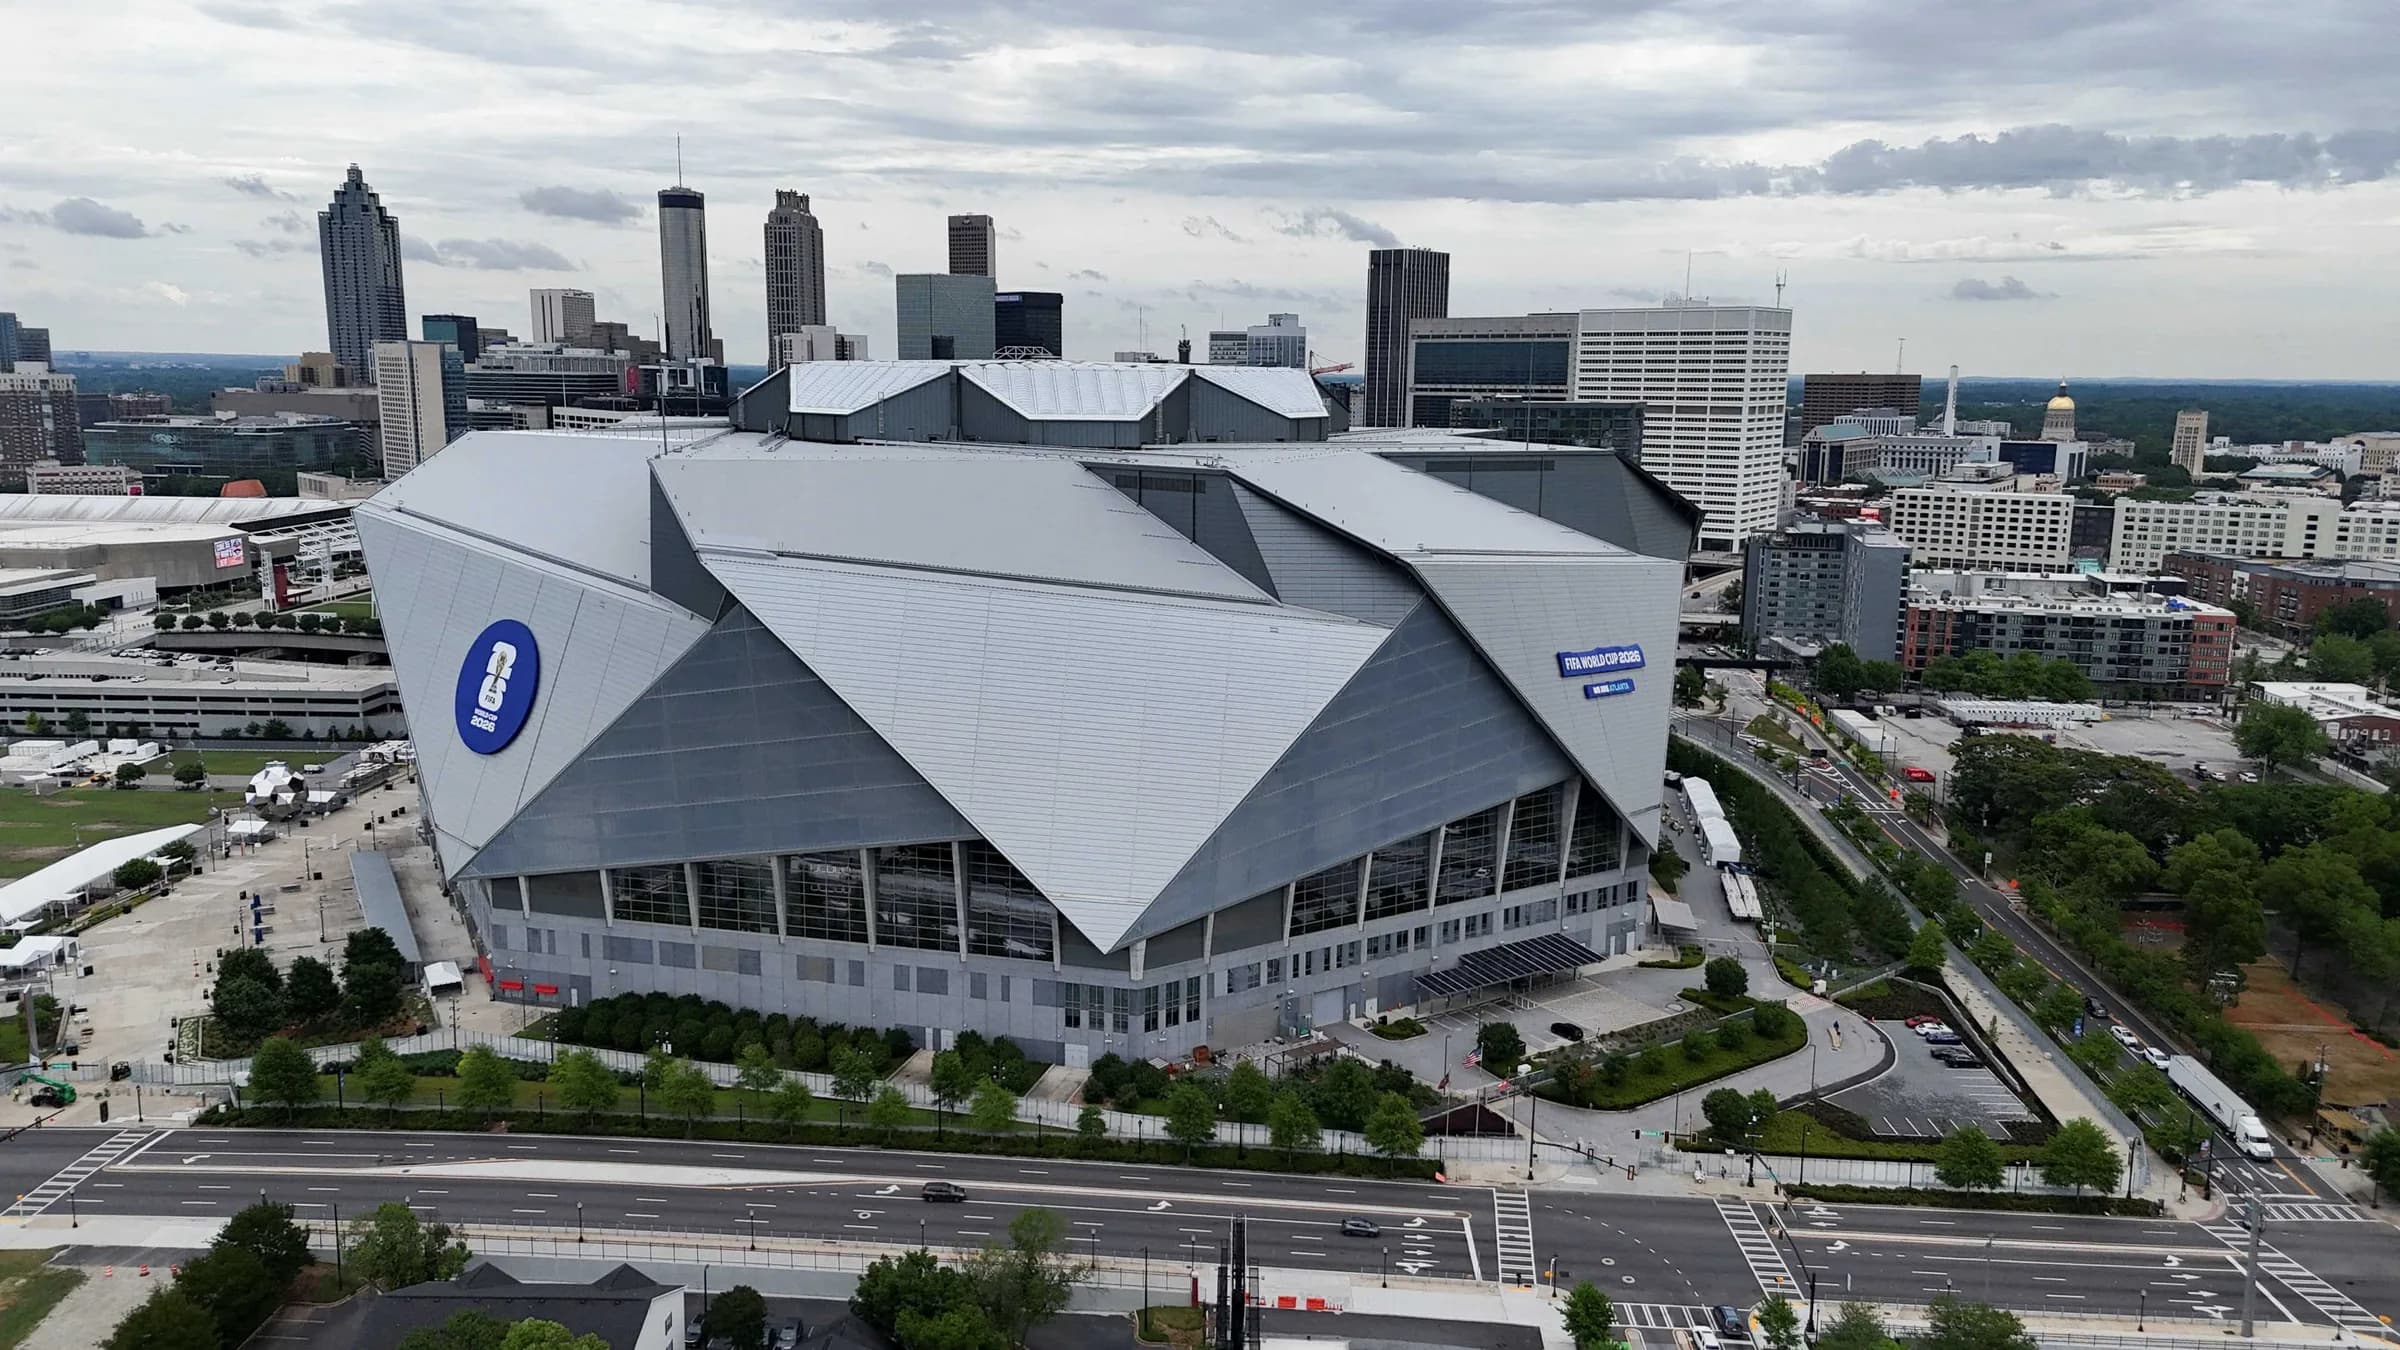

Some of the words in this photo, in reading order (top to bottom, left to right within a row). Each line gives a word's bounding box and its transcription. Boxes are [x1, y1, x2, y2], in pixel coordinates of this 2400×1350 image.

[1564, 657, 1582, 670] FIFA
[1580, 653, 1605, 669] WORLD
[1605, 652, 1619, 665] CUP
[1618, 650, 1641, 664] 2026
[484, 694, 496, 704] FIFA
